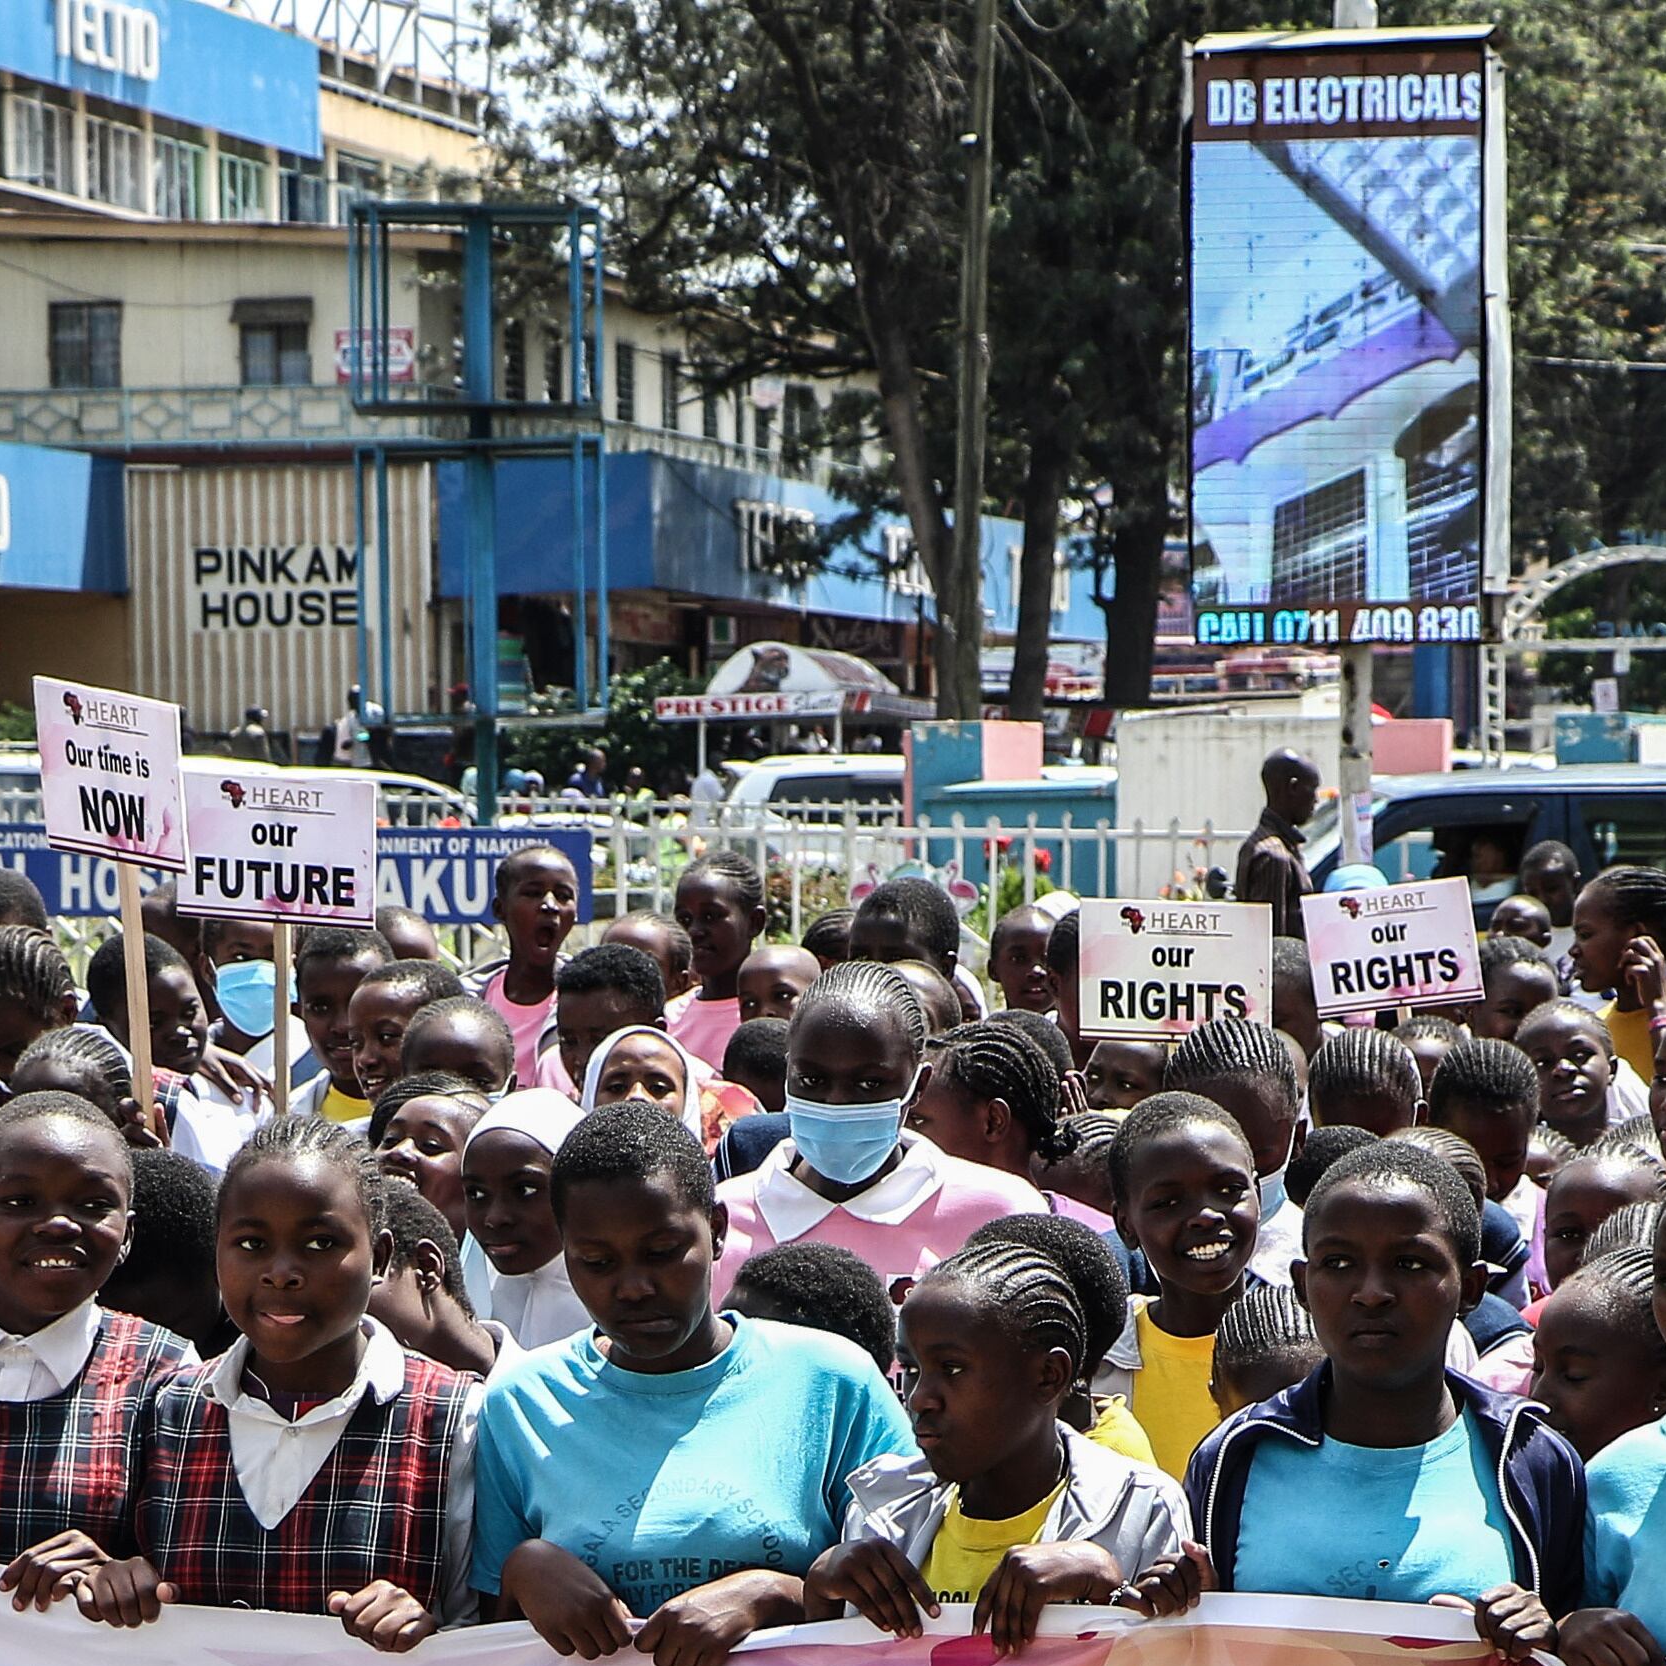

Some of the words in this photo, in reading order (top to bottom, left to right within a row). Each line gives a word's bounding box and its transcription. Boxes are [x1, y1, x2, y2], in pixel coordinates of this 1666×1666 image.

[1207, 79, 1257, 126] DB
[1263, 71, 1481, 125] ELECTRICALS
[201, 590, 358, 629] HOUSE
[86, 700, 139, 727] HEART
[656, 696, 789, 718] PRESTIGE
[65, 740, 93, 769] Our
[98, 747, 132, 776] time
[135, 752, 151, 779] is
[252, 787, 325, 808] HEART
[78, 785, 146, 842] NOW
[251, 825, 298, 848] our
[195, 856, 356, 907] FUTURE
[1366, 892, 1427, 911] HEART
[1150, 912, 1222, 931] HEART
[1370, 921, 1408, 944] our
[1151, 946, 1195, 968] our
[1330, 948, 1461, 996] RIGHTS
[1099, 979, 1248, 1023] RIGHTS
[662, 1557, 702, 1579] THE
